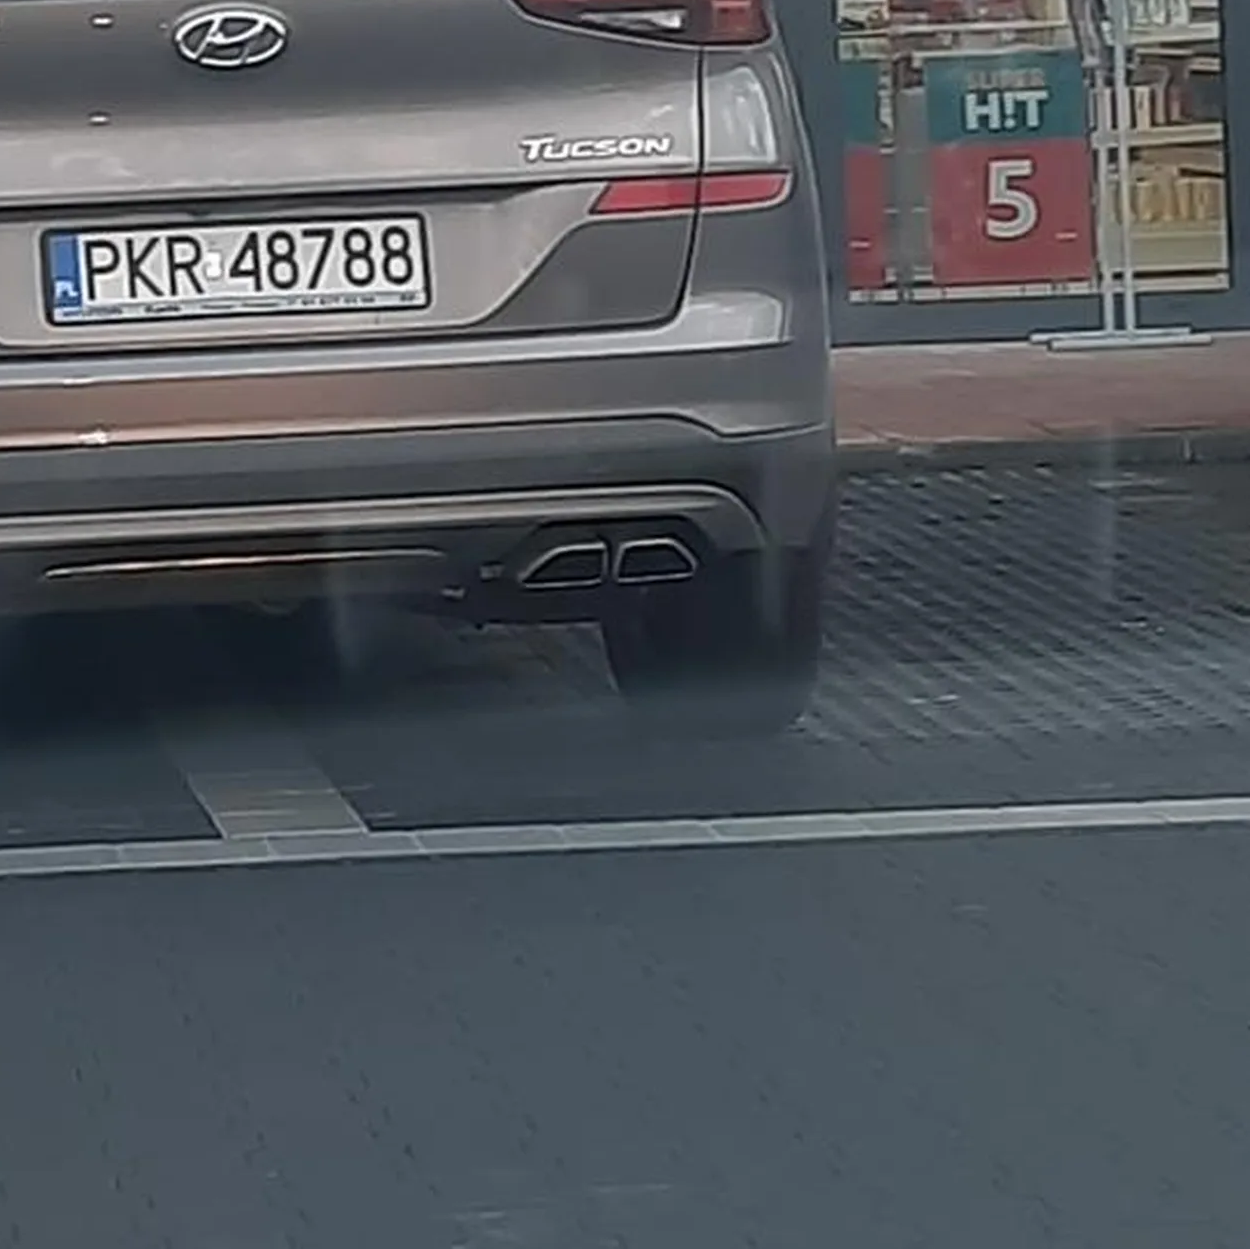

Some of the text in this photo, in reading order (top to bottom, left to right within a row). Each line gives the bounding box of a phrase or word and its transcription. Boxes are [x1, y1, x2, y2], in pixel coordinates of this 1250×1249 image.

[986, 159, 1039, 239] 5
[83, 225, 415, 300] PKR 48788
